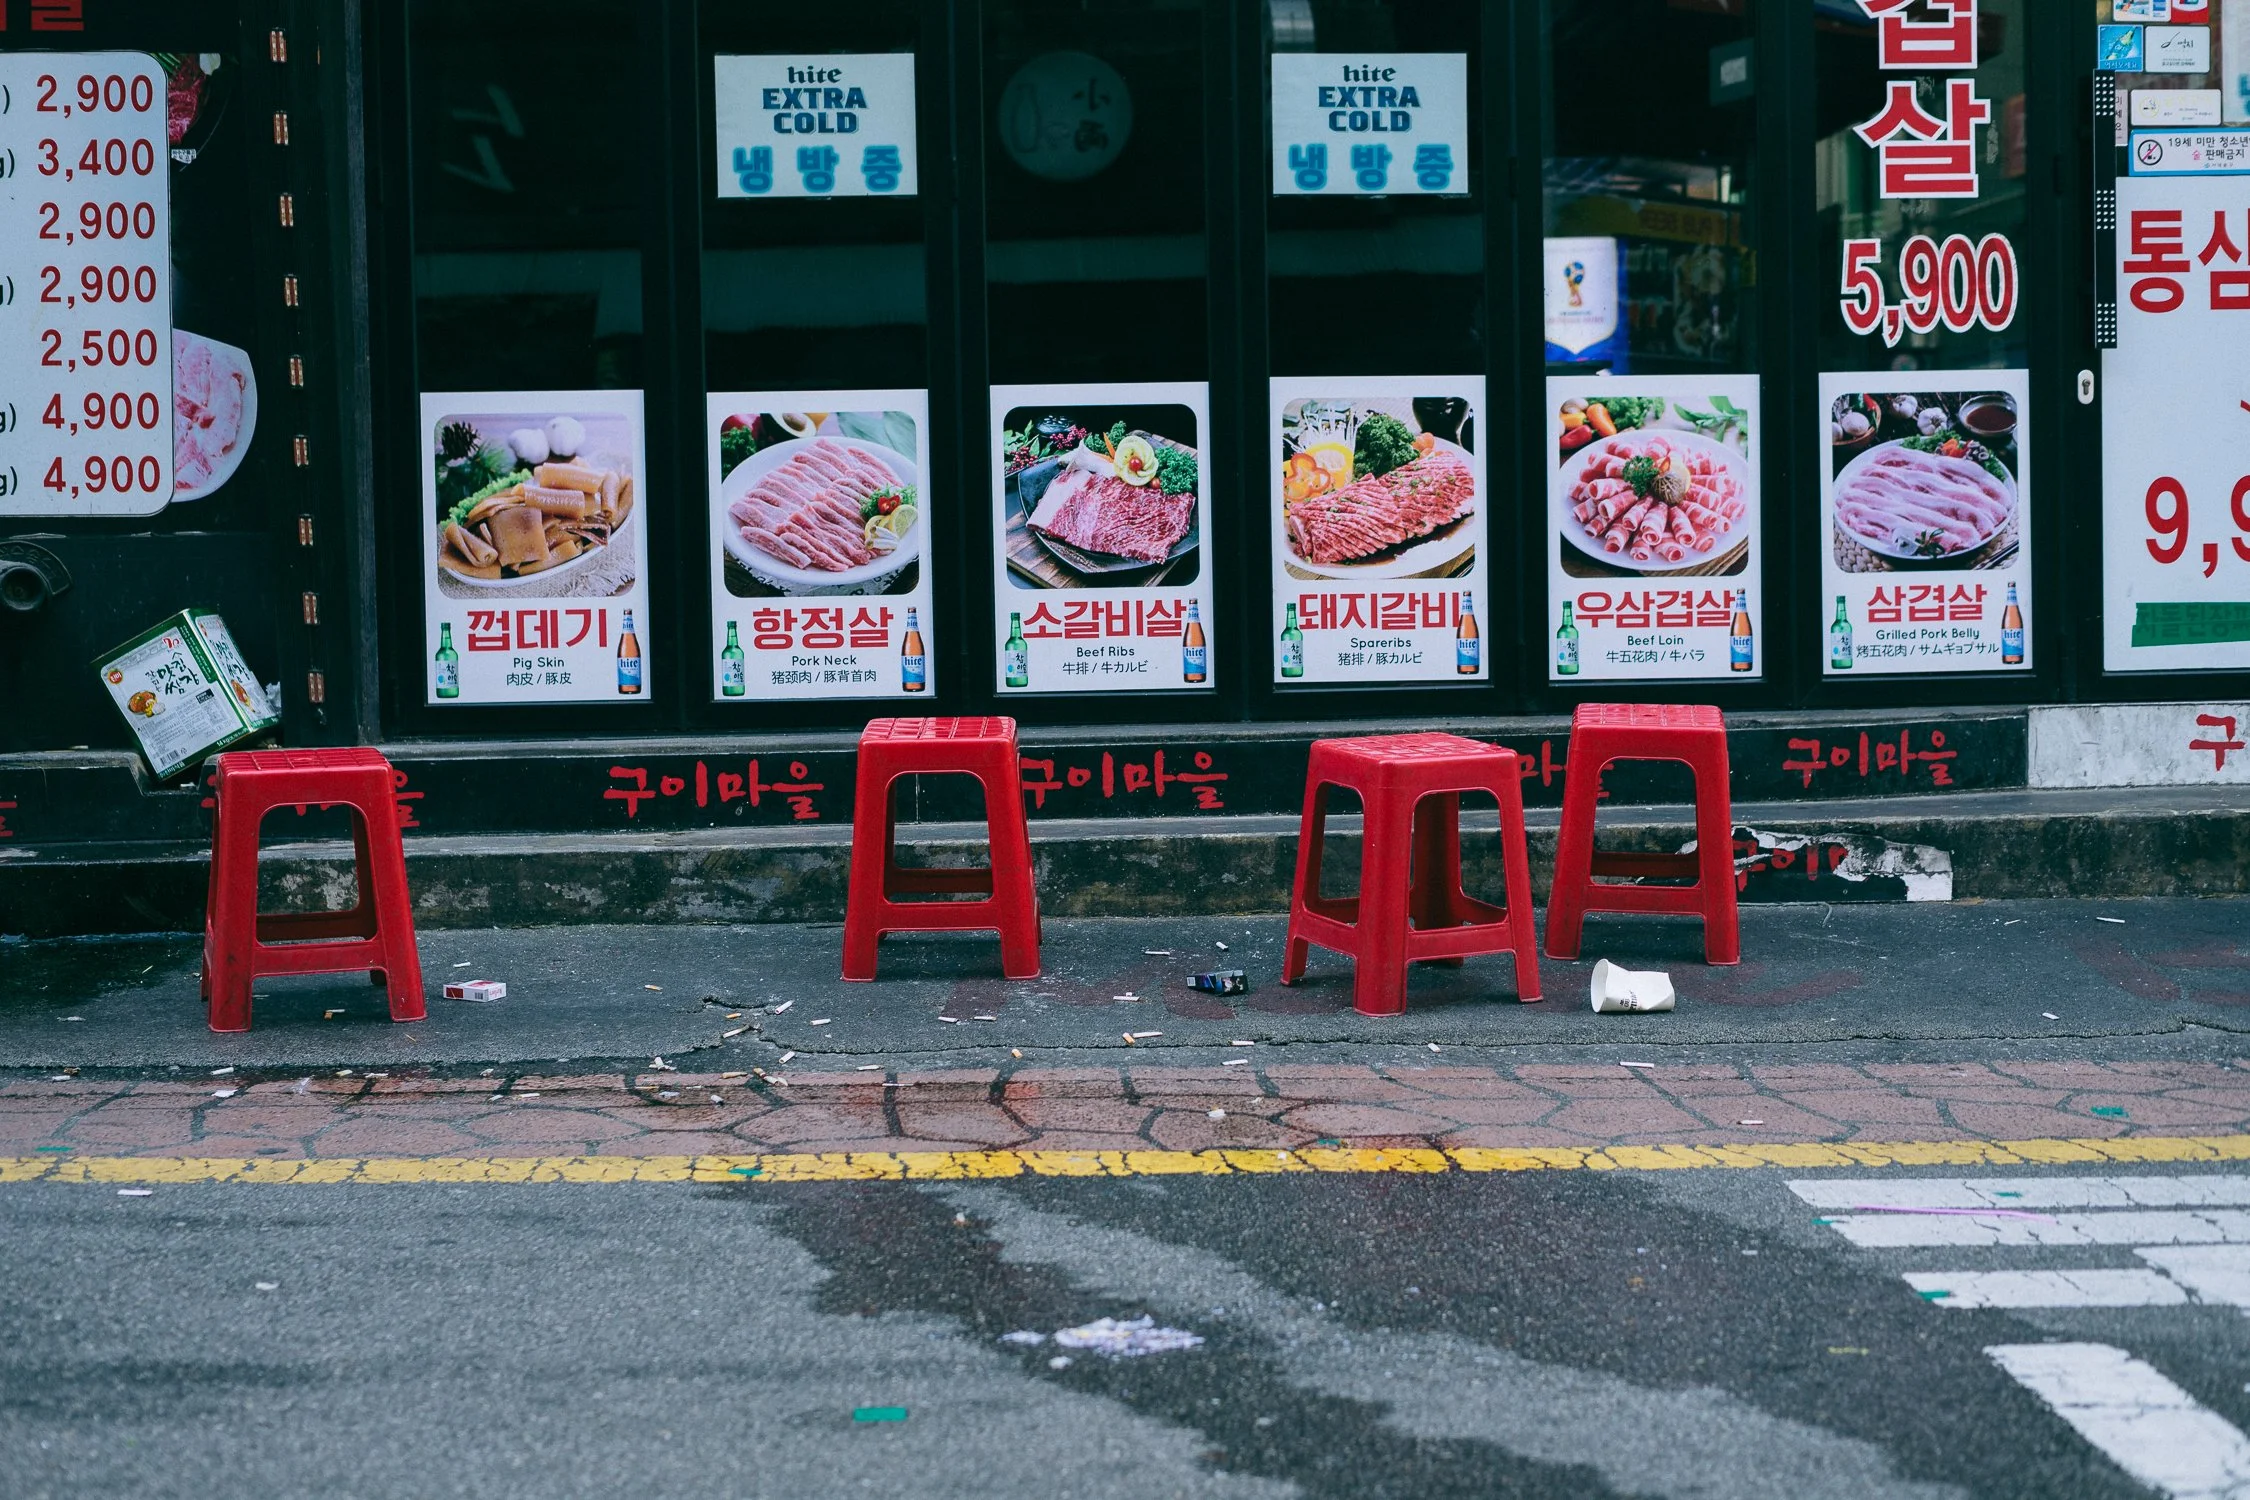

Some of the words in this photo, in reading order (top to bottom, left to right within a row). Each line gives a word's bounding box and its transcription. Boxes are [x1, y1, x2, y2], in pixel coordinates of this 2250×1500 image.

[787, 66, 842, 84] hite
[1343, 64, 1396, 82] hite
[37, 75, 153, 118] 2,900
[762, 86, 868, 110] EXTRA
[1318, 85, 1421, 109] EXTRA
[773, 111, 859, 135] COLD
[1328, 110, 1412, 133] COLD
[2168, 137, 2192, 147] 19세
[2196, 136, 2215, 148] 미만
[38, 139, 154, 182] 3,400
[2205, 149, 2245, 161] 판매금지
[39, 201, 155, 245] 2,900
[40, 265, 156, 309] 2,900
[1840, 234, 2018, 348] 5,900
[41, 328, 158, 372] 2,500
[42, 391, 160, 436] 4,900
[43, 455, 161, 499] 4,900
[1298, 591, 1462, 631] 돼지갈비
[1575, 590, 1736, 629] 우삼겹살
[1867, 584, 1987, 623] 삼겹살
[466, 608, 608, 652] 껍데기
[752, 607, 895, 650] 항정살
[1022, 599, 1188, 639] 소갈비살
[1350, 636, 1412, 651] Spareribs
[1460, 639, 1477, 649] hite
[1627, 634, 1655, 646] Beef
[1658, 634, 1684, 646] Loin
[1733, 637, 1750, 646] hite
[1875, 628, 1917, 641] Grilled
[1920, 628, 1948, 640] Pork
[1951, 627, 1980, 641] Belly
[2004, 629, 2021, 639] hite
[620, 658, 638, 668] hite
[791, 655, 820, 667] Pork
[824, 654, 857, 666] Neck
[904, 656, 922, 666] hite
[1076, 646, 1105, 658] Beef
[1108, 645, 1135, 657] Ribs
[1186, 648, 1203, 657] hite
[1338, 653, 1364, 666] 猪排
[1376, 652, 1422, 665] 豚カルビ
[1606, 650, 1657, 663] 牛五花肉
[1670, 649, 1704, 662] 牛バラ
[513, 657, 533, 671] Pig
[537, 656, 565, 668] Skin
[1063, 662, 1089, 675] 牛排
[1101, 660, 1148, 674] 牛カルビ
[507, 669, 533, 686] 肉皮
[546, 672, 572, 685] 豚皮
[824, 669, 876, 683] 豚背首肉
[2188, 713, 2246, 771] 구
[1783, 730, 1957, 787] 구이마을
[604, 760, 824, 820] 구이마을
[1019, 750, 1228, 809] 구이마을
